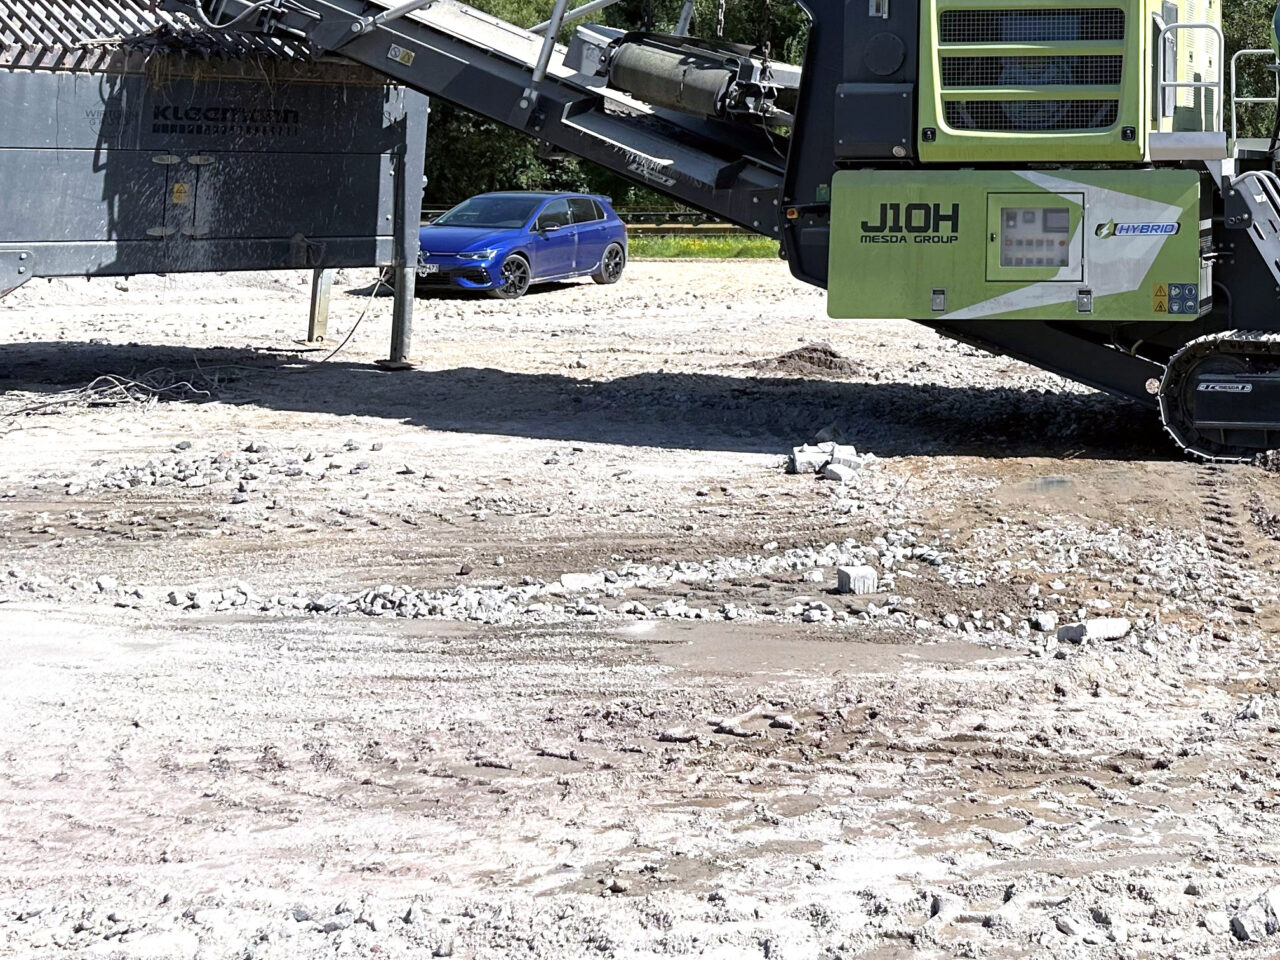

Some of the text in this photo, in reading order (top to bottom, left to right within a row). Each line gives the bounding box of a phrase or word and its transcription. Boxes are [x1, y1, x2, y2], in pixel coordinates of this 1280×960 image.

[861, 203, 959, 233] J10H
[1118, 224, 1176, 234] HYBRID
[860, 235, 959, 244] MESDA GROUP
